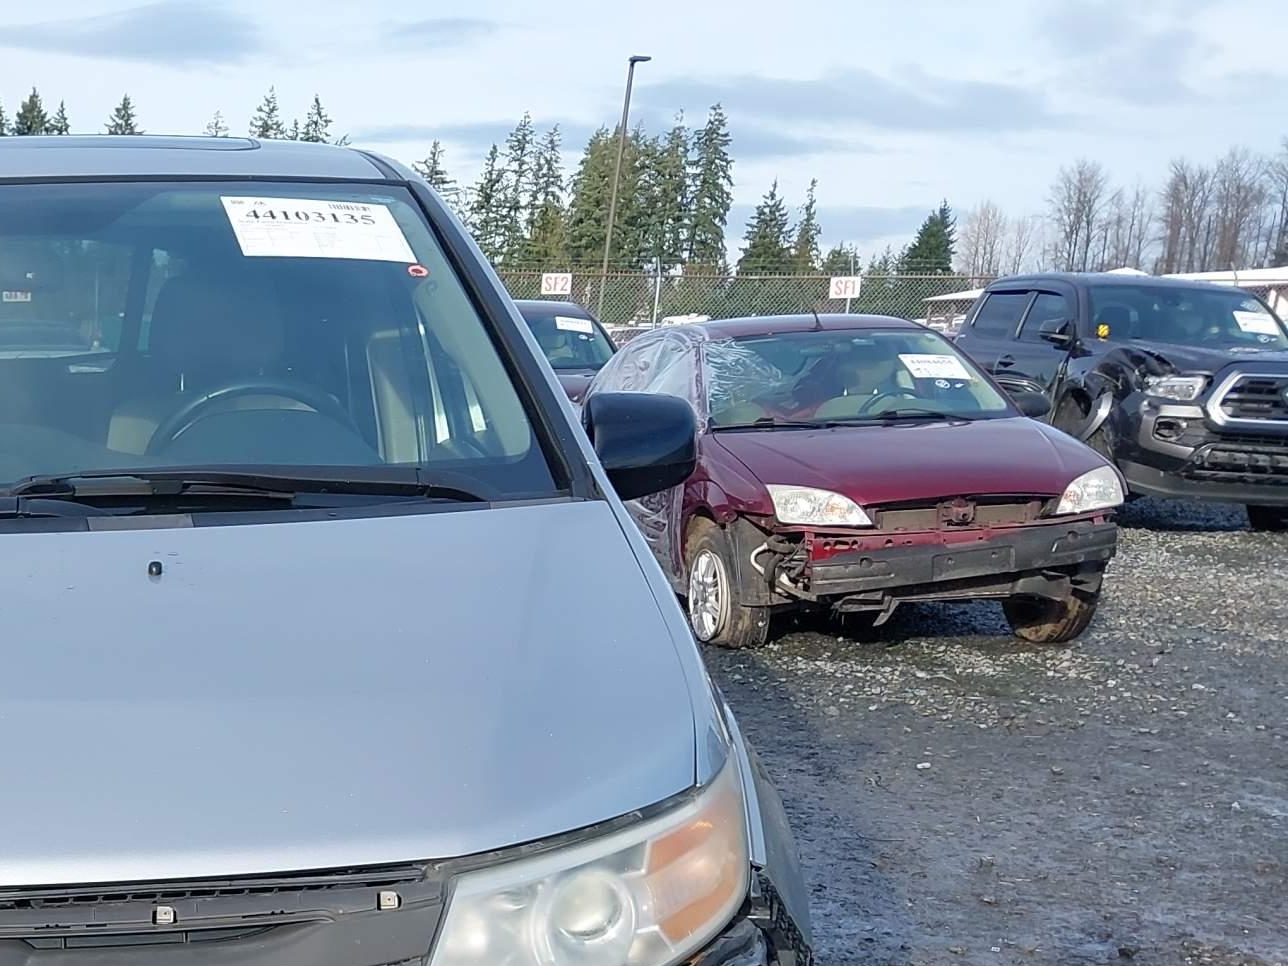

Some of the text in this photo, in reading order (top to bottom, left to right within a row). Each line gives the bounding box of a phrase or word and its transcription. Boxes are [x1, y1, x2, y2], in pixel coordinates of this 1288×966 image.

[245, 208, 376, 226] 44103135
[544, 276, 569, 292] SF2
[834, 279, 856, 296] SF1
